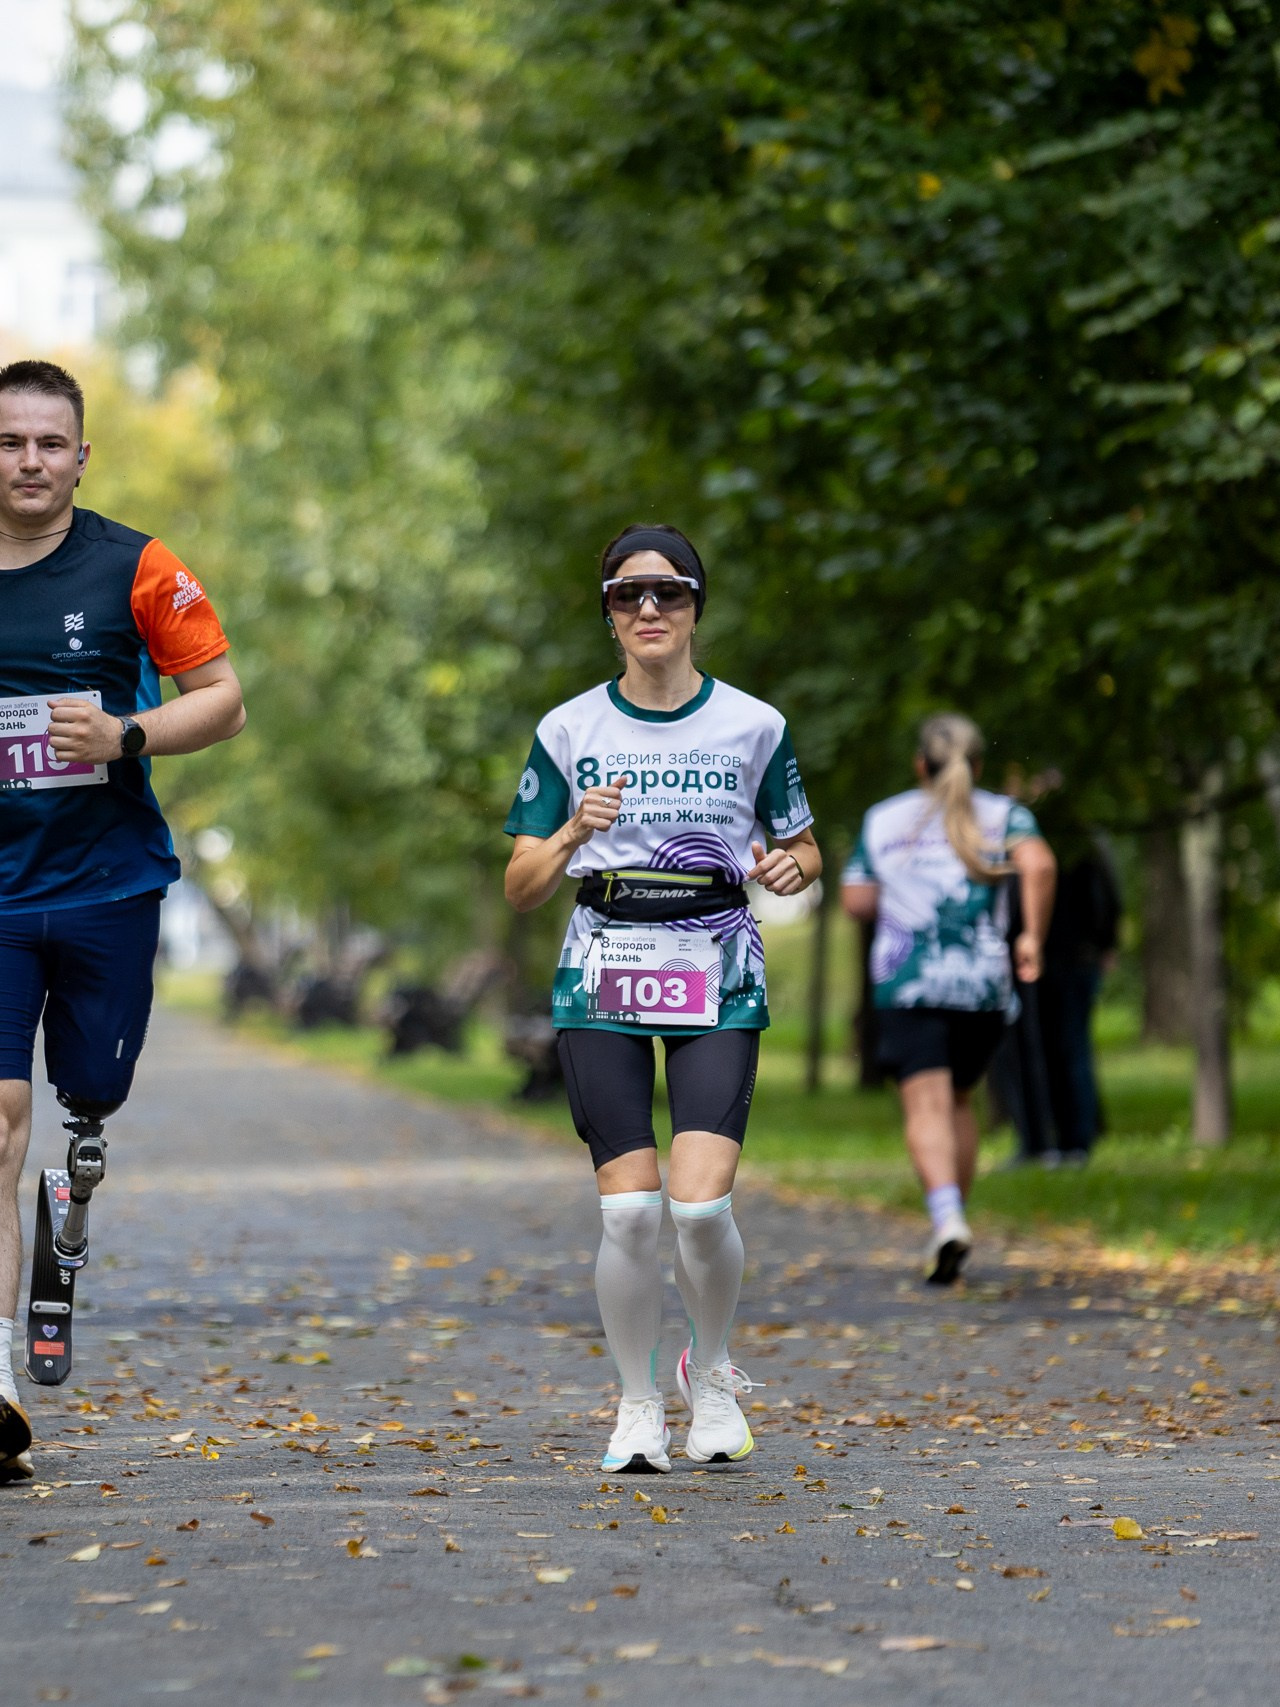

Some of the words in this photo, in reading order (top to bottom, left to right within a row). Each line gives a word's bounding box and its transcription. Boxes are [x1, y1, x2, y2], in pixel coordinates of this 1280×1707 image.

[14, 701, 39, 710] забегов
[606, 753, 662, 768] серия
[668, 749, 742, 769] забегов
[576, 757, 601, 791] 8
[606, 769, 738, 795] городов
[622, 796, 702, 808] орительного
[705, 796, 738, 810] фонда
[641, 812, 672, 825] для
[676, 809, 734, 826] Жизни»
[631, 889, 697, 899] DEMIX
[601, 936, 610, 949] 8
[612, 941, 656, 952] городов
[600, 953, 642, 963] КАЗАНЬ
[616, 976, 688, 1008] 103
